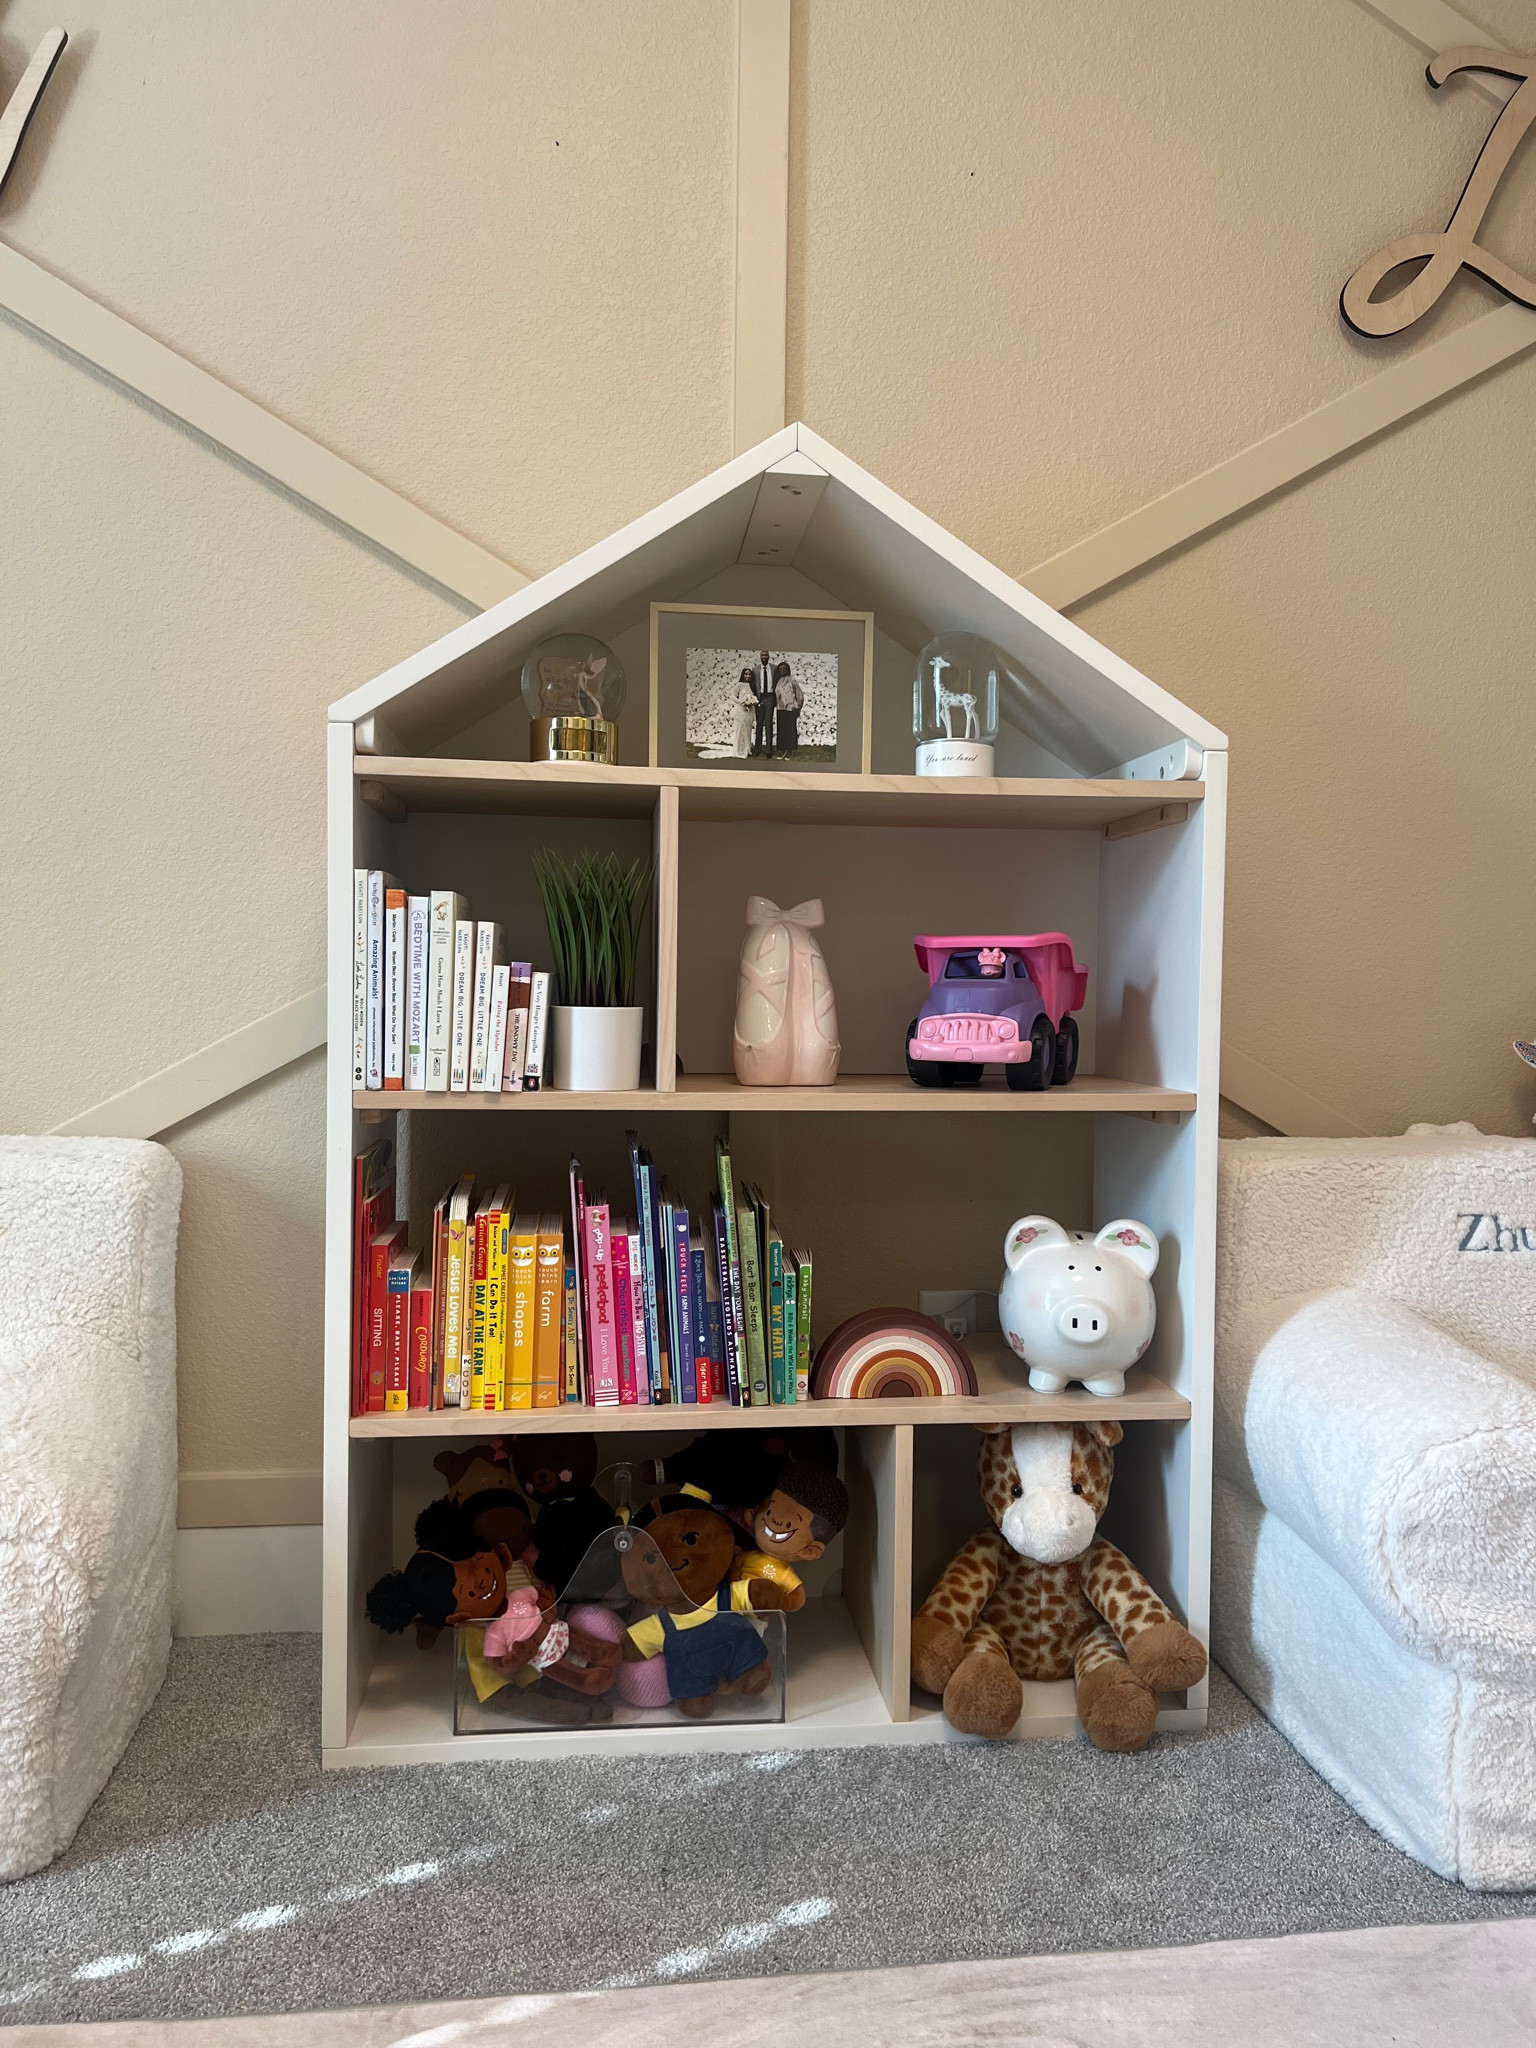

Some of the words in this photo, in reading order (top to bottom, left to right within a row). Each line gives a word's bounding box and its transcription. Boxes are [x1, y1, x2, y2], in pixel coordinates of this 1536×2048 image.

[925, 754, 939, 766] You
[954, 753, 980, 761] loved
[371, 939, 379, 968] Amazing
[413, 923, 423, 969] BEDTIME
[371, 969, 379, 999] Animals!
[412, 972, 422, 998] WITH
[477, 996, 485, 1009] BIG,
[411, 1001, 421, 1043] MOZART
[533, 1005, 541, 1024] Hungry
[493, 1029, 502, 1052] Alphabet
[512, 1025, 520, 1050] SNOWY
[531, 1026, 540, 1054] Caterpillar
[724, 1161, 732, 1190] JACQUELINE
[479, 1218, 487, 1246] Curious
[592, 1228, 604, 1262] pop-up
[679, 1242, 688, 1268] TOUCH
[376, 1254, 384, 1278] Frazier
[449, 1255, 461, 1293] Jesus
[719, 1237, 729, 1292] BASKETBALL
[732, 1267, 740, 1280] THE
[746, 1260, 756, 1279] Bart
[490, 1284, 499, 1297] Can
[619, 1278, 628, 1306] Chica
[633, 1281, 641, 1297] How
[648, 1270, 656, 1301] Hair
[680, 1274, 688, 1293] FEEL
[733, 1281, 741, 1294] DAY
[748, 1282, 757, 1302] Bear
[801, 1274, 809, 1291] Baby
[475, 1285, 486, 1305] DAY
[489, 1300, 499, 1310] Do
[593, 1264, 610, 1325] peekaboo!
[681, 1295, 689, 1311] FARM
[734, 1296, 743, 1311] YOU
[474, 1309, 485, 1322] AT
[540, 1290, 555, 1327] farm
[635, 1306, 643, 1314] Be
[724, 1296, 734, 1336] LEGENDS
[748, 1305, 759, 1333] Sleeps
[772, 1305, 783, 1323] MY
[373, 1308, 383, 1347] SITTING
[512, 1292, 529, 1347] shapes
[621, 1308, 629, 1334] chica
[682, 1312, 690, 1335] ANIMALS
[736, 1313, 744, 1332] BEGIN
[474, 1325, 485, 1344] THE
[488, 1323, 498, 1338] Too!
[568, 1327, 576, 1344] ABC
[600, 1335, 609, 1355] Love
[712, 1348, 720, 1359] Star
[772, 1327, 784, 1359] HAIR
[473, 1347, 484, 1376] FARM
[601, 1357, 610, 1373] You
[699, 1363, 708, 1379] tiger
[713, 1365, 721, 1378] tiger
[727, 1341, 737, 1386] ALPHABET
[700, 1381, 709, 1397] tales
